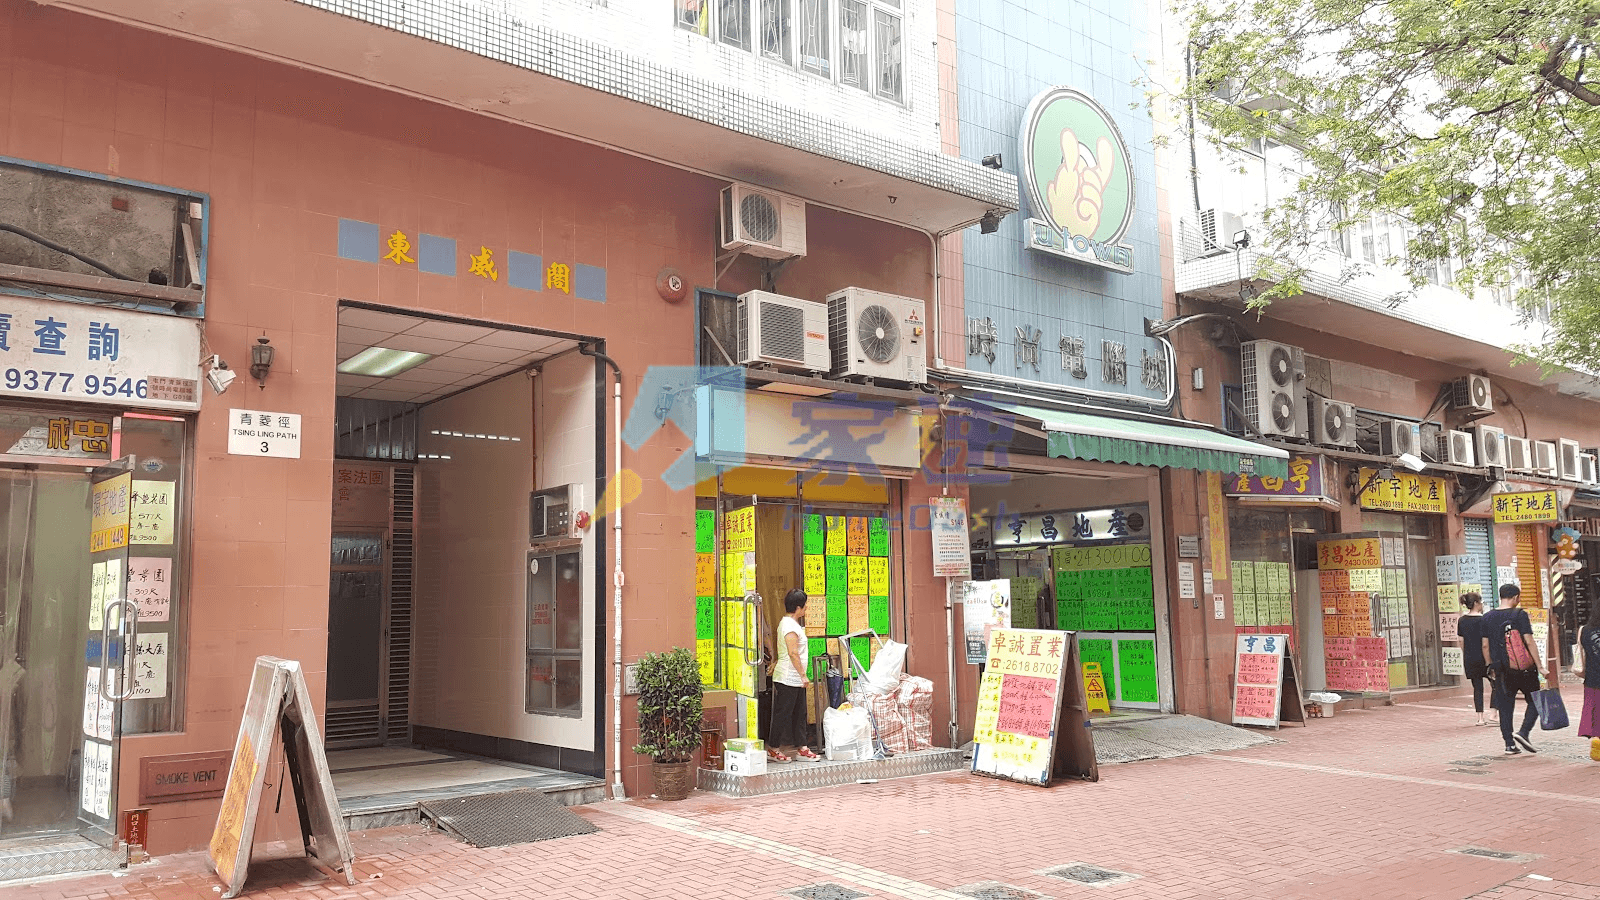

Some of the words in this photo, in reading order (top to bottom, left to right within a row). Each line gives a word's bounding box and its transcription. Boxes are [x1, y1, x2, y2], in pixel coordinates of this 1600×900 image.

[384, 230, 570, 294] 東威閣
[5, 368, 74, 393] 9377
[84, 374, 147, 399] 9546
[240, 413, 291, 428] 青菱徑
[233, 429, 256, 437] TSING
[260, 441, 269, 453] 3
[1368, 474, 1440, 500] 新宇地產
[1495, 493, 1555, 513] 新宇地產
[1008, 509, 1130, 543] 亨昌地產
[1320, 541, 1376, 566] 亨昌地產
[1362, 558, 1379, 566] 0100
[991, 632, 1062, 658] 卓誠置業
[1244, 636, 1276, 653] 亨昌
[1032, 662, 1058, 674] 8702
[155, 772, 189, 785] SMOKE
[193, 769, 218, 783] VENT
